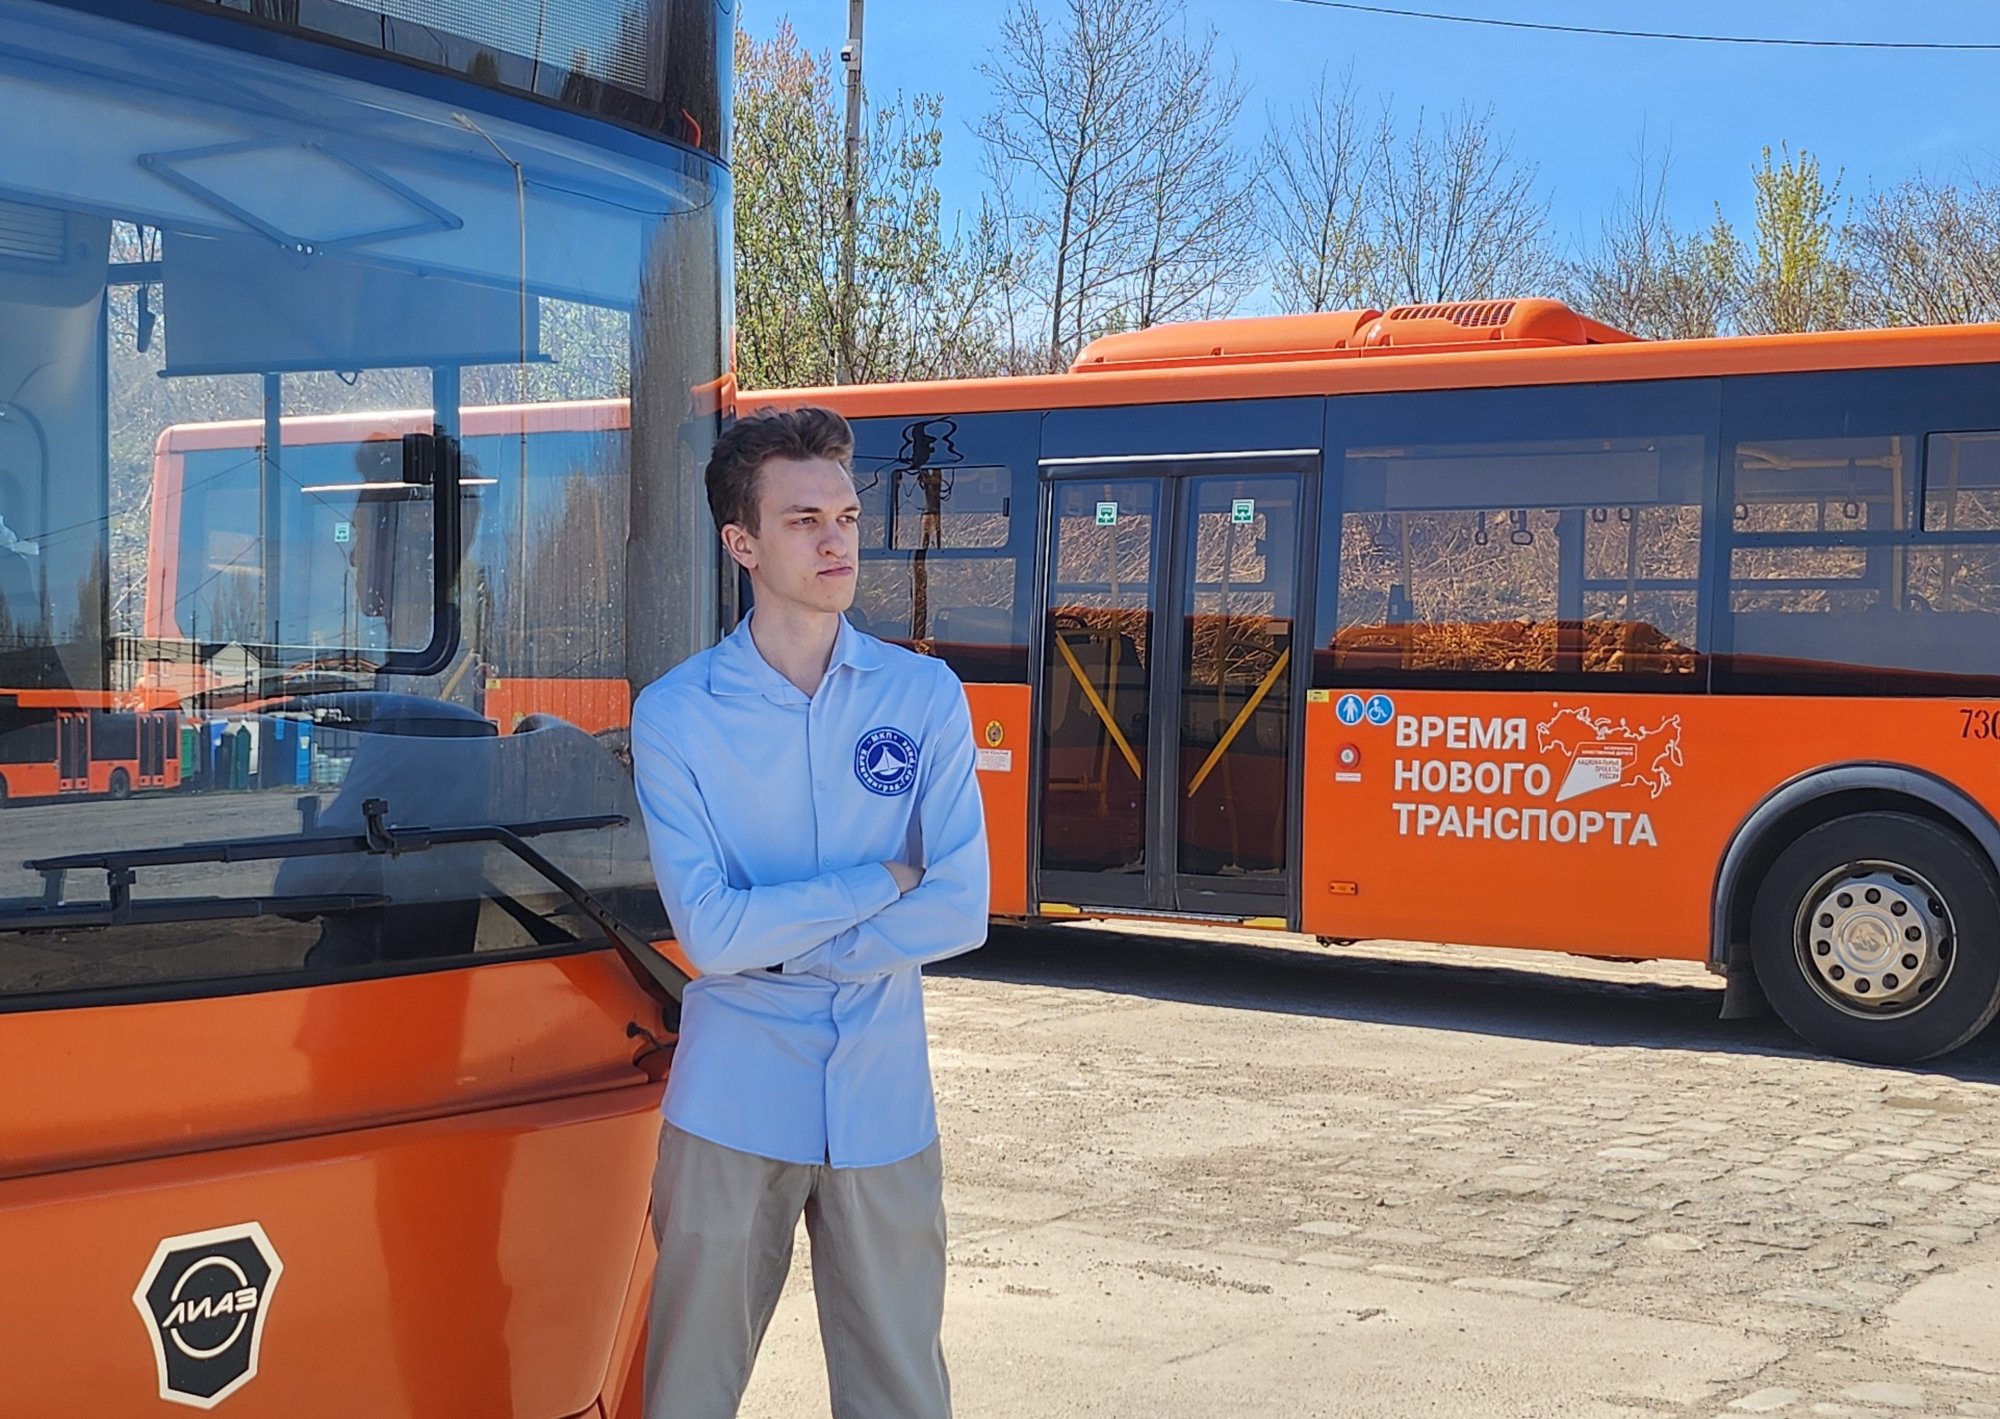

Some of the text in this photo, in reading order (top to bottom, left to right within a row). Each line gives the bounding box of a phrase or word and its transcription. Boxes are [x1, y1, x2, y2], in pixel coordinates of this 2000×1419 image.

[871, 732, 892, 742] МКП
[1395, 715, 1527, 750] ВРЕМЯ
[1394, 759, 1551, 796] НОВОГО
[1392, 803, 1658, 847] ТРАНСПОРТА
